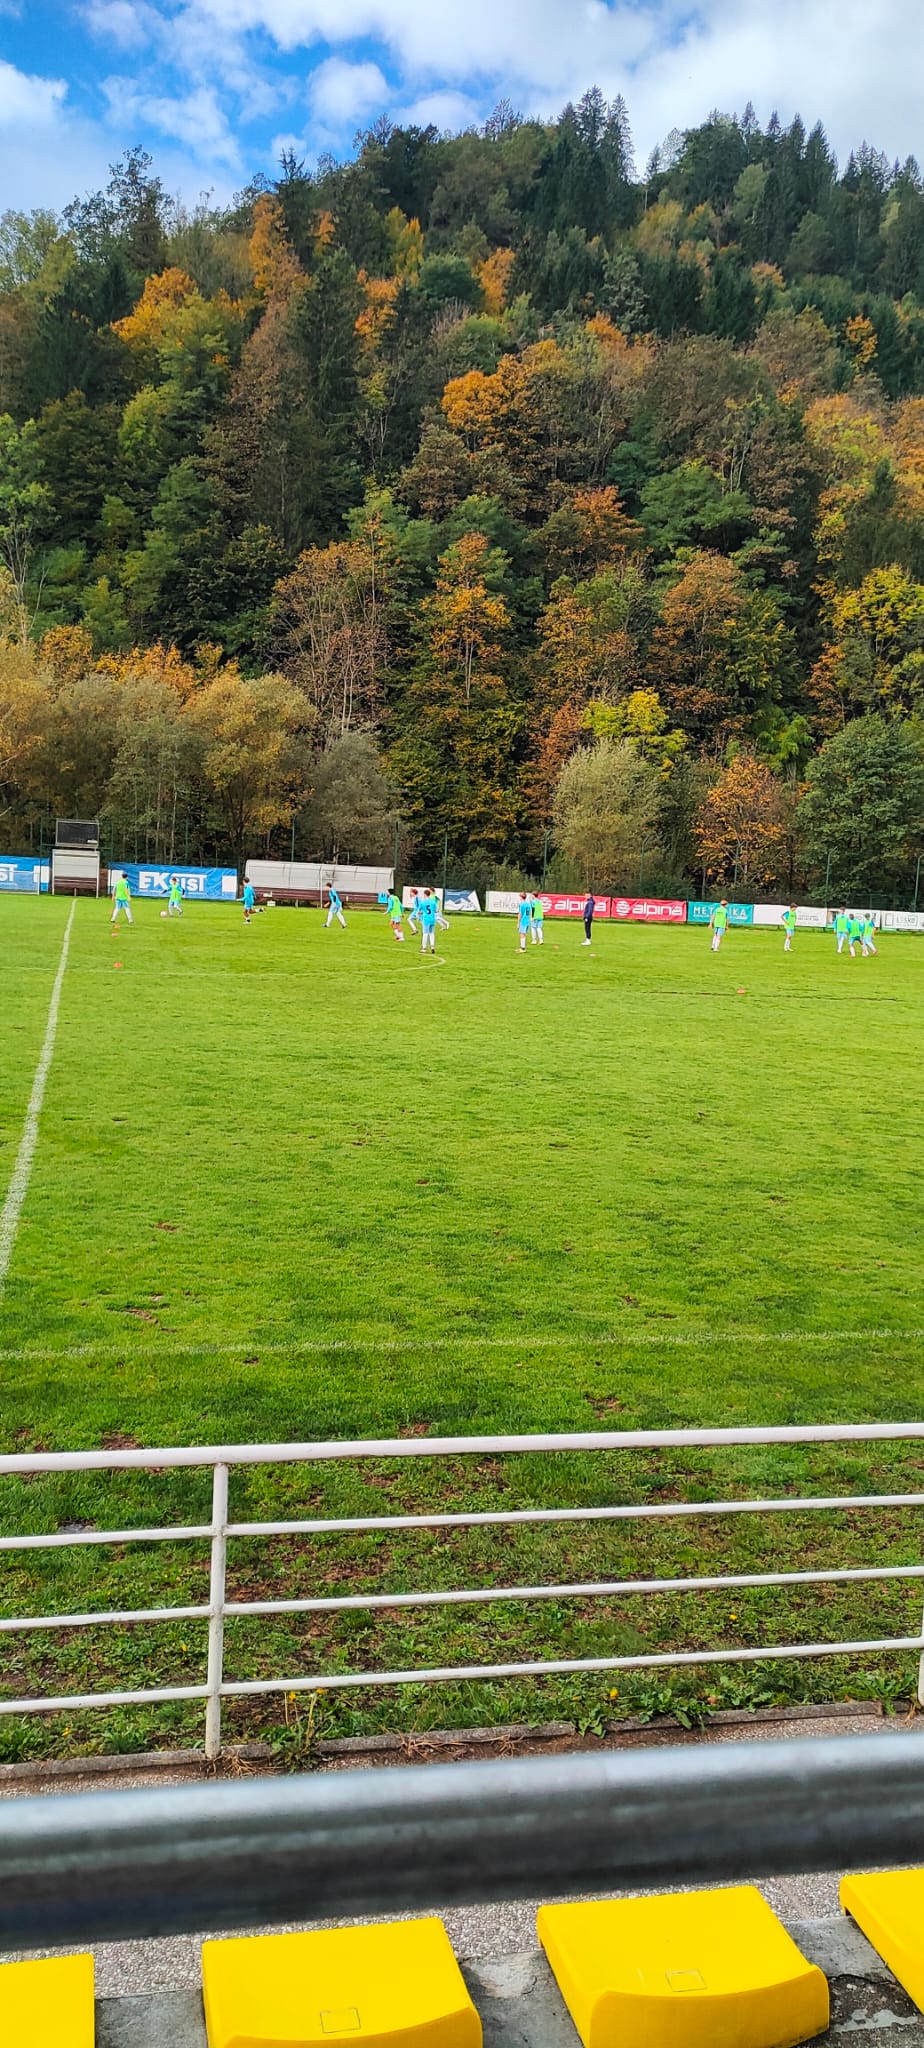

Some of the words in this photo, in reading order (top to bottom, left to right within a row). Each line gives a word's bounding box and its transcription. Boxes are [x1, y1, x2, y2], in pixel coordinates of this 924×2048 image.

[139, 872, 207, 892] EKIST
[426, 904, 432, 915] 5
[555, 898, 606, 912] alpia
[632, 902, 682, 915] alpina
[693, 906, 746, 916] METIKA
